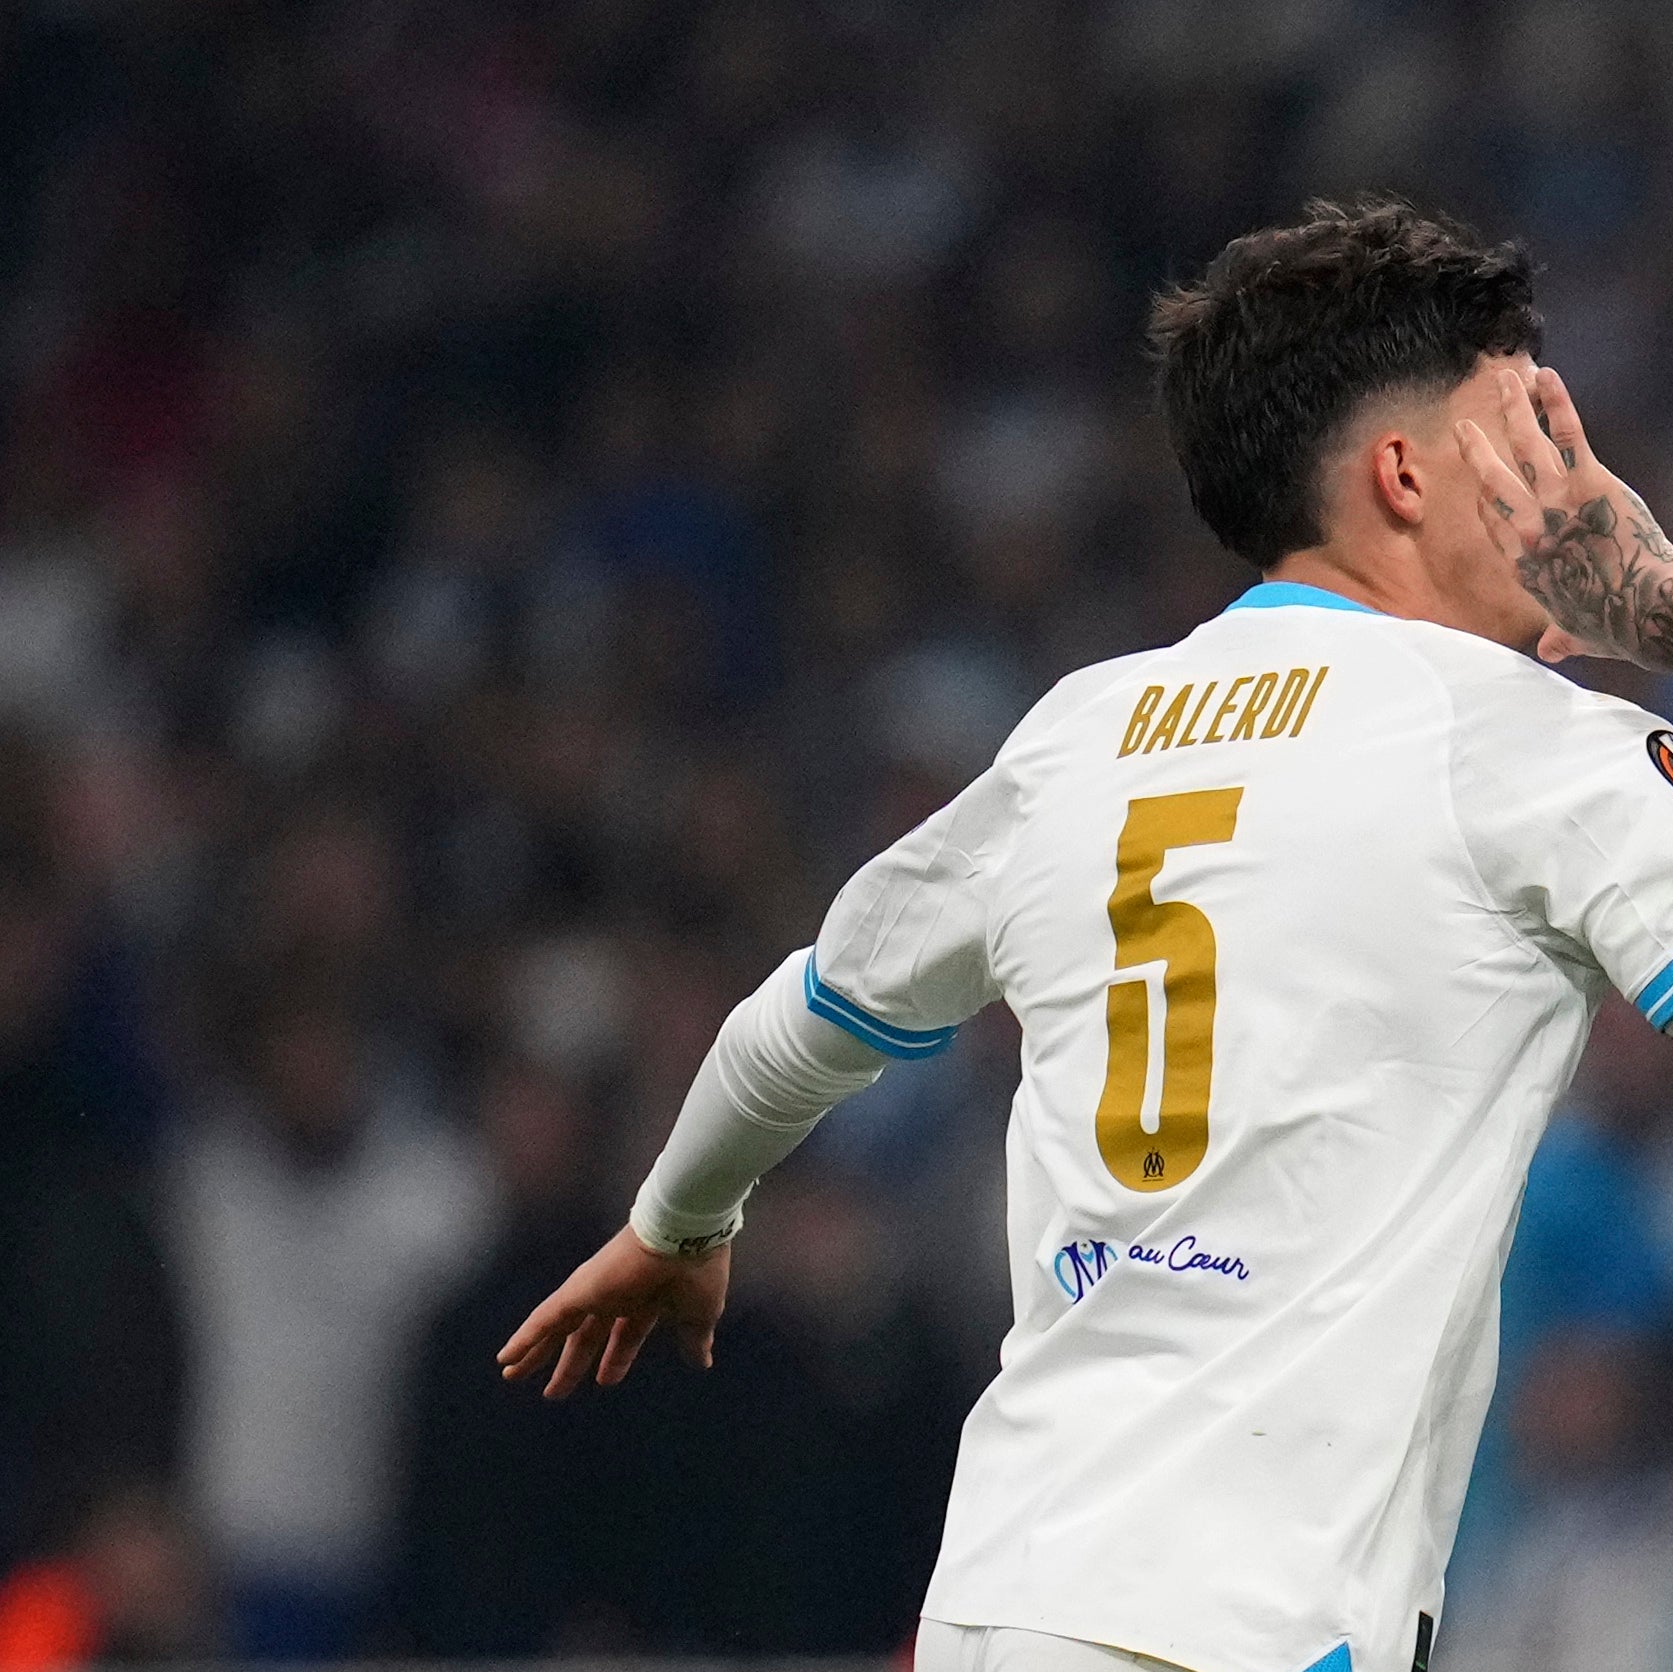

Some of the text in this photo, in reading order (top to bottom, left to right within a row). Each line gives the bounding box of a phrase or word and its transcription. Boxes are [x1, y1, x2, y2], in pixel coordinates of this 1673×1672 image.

[1115, 666, 1329, 760] BALERDI
[1094, 786, 1245, 1193] 5
[1128, 1244, 1165, 1265] au
